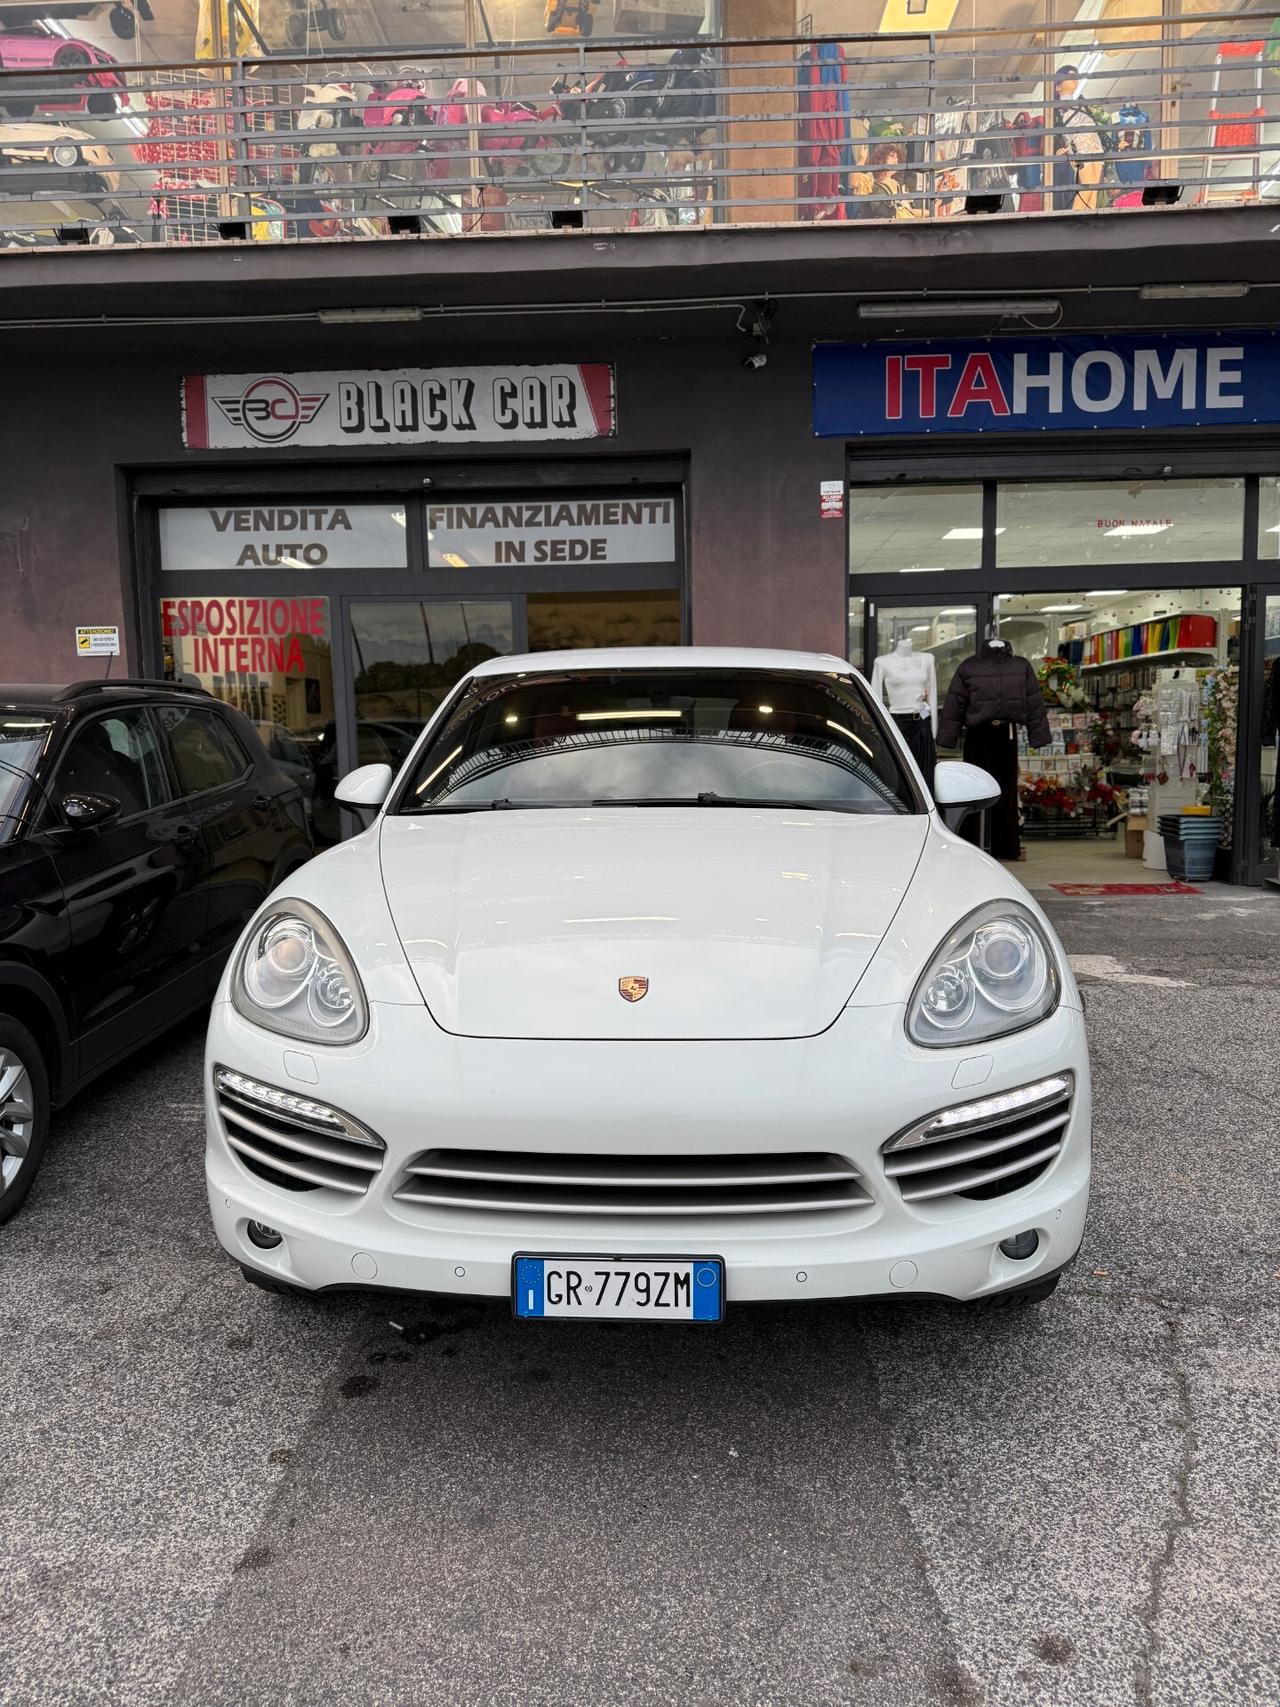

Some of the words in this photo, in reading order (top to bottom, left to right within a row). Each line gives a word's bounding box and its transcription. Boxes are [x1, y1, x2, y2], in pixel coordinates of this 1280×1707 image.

[885, 346, 1244, 419] ITAHOME
[338, 378, 476, 433] BLACK
[491, 375, 577, 430] CAR
[209, 508, 352, 532] VENDITA
[428, 501, 671, 530] FINANZIAMENTI
[1097, 519, 1125, 528] BUON
[236, 543, 328, 566] AUTO
[494, 540, 526, 563] IN
[533, 538, 607, 562] SEDE
[162, 598, 325, 637] ESPOSIZIONE
[193, 637, 305, 673] INTERNA
